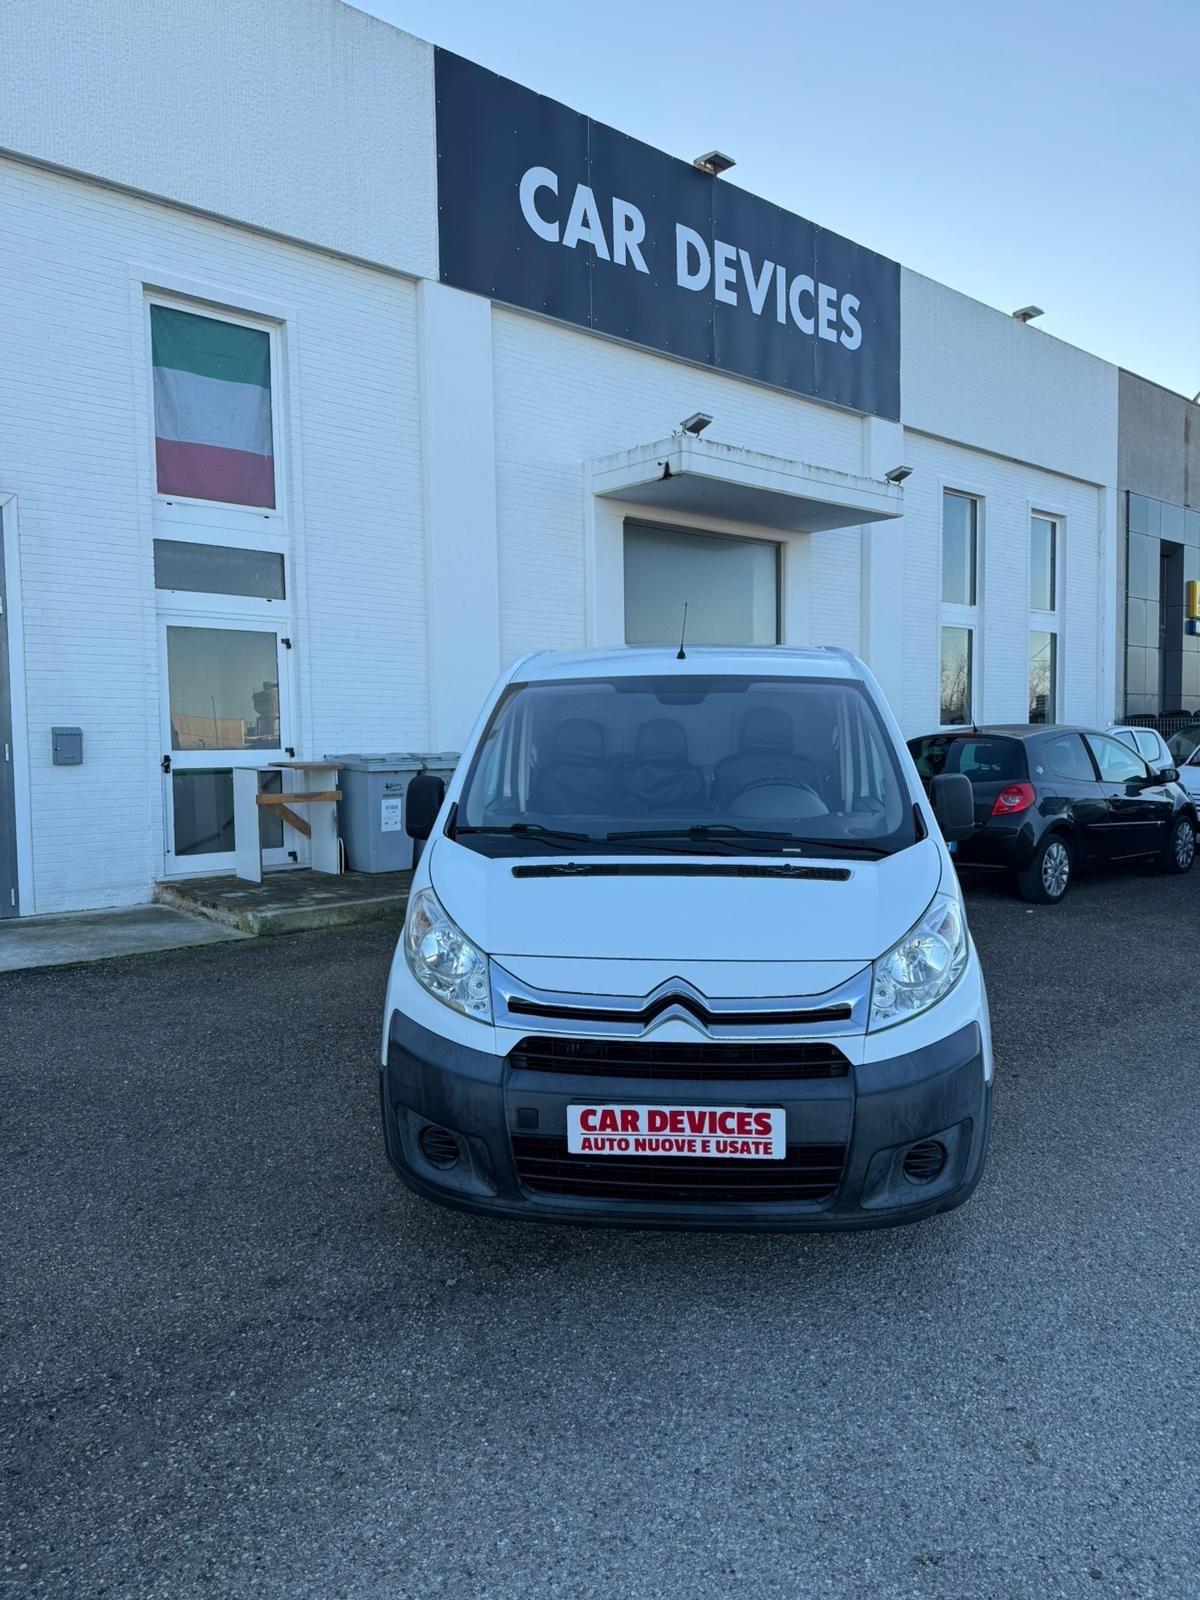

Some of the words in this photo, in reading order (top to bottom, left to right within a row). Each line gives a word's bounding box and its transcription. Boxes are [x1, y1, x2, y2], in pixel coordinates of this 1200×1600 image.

[519, 166, 650, 275] CAR
[676, 222, 863, 351] DEVICES
[580, 1109, 640, 1133] CAR
[647, 1110, 772, 1136] DEVICES
[581, 1137, 630, 1152] AUTO
[634, 1138, 697, 1153] NUOVE
[701, 1140, 711, 1154] E
[715, 1140, 773, 1155] USATE
